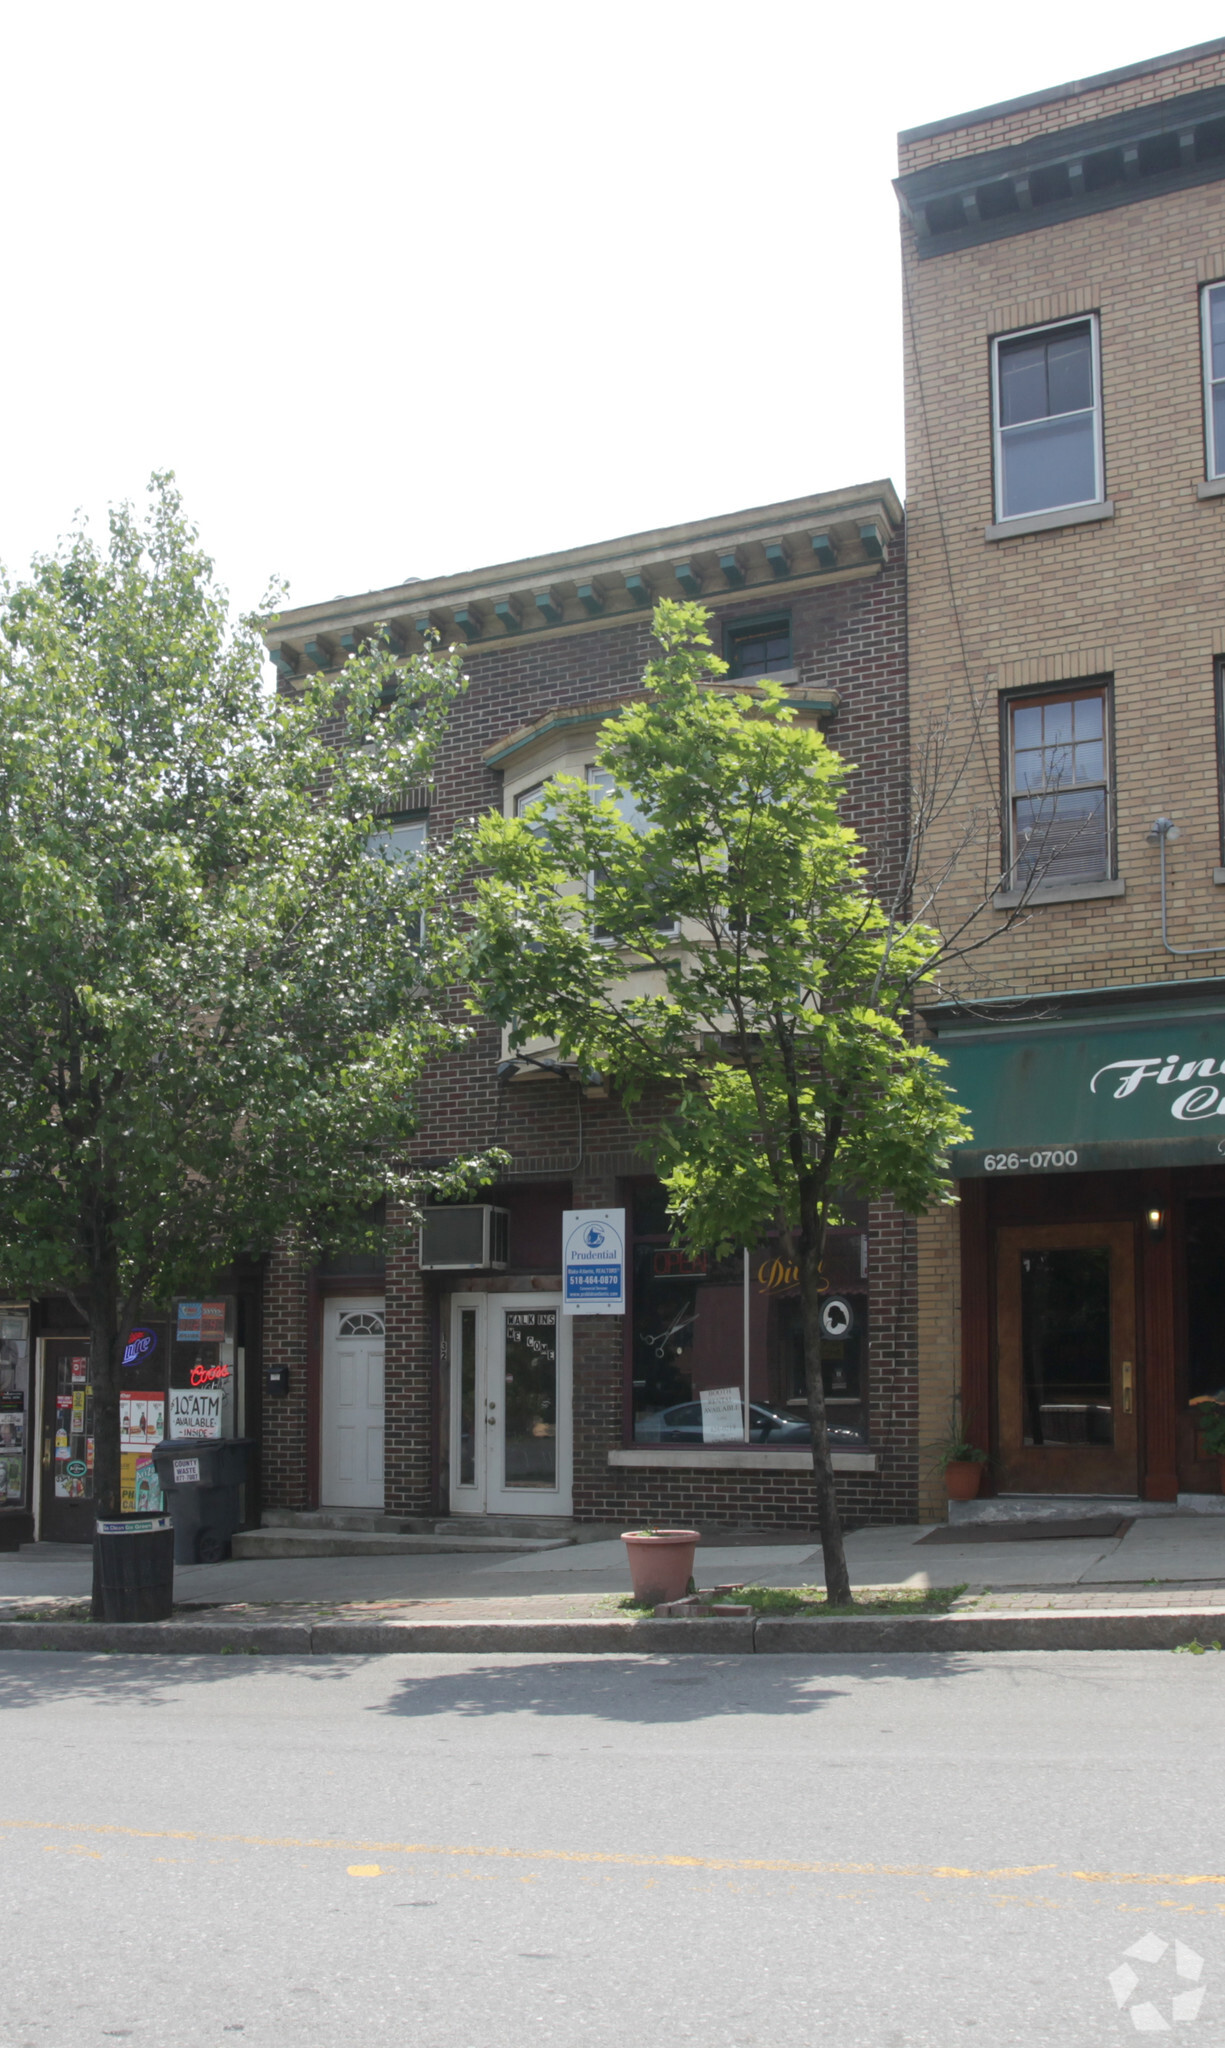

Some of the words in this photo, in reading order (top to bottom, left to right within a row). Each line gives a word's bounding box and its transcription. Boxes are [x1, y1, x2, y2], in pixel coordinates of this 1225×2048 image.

[983, 1149, 1078, 1171] 626-0700
[571, 1250, 617, 1260] Prudential
[569, 1275, 618, 1285] 518-464-0870
[507, 1314, 535, 1325] WALK
[538, 1314, 556, 1325] INS
[190, 1364, 231, 1387] Coors
[192, 1396, 219, 1416] ATM
[174, 1460, 197, 1468] COUNTY
